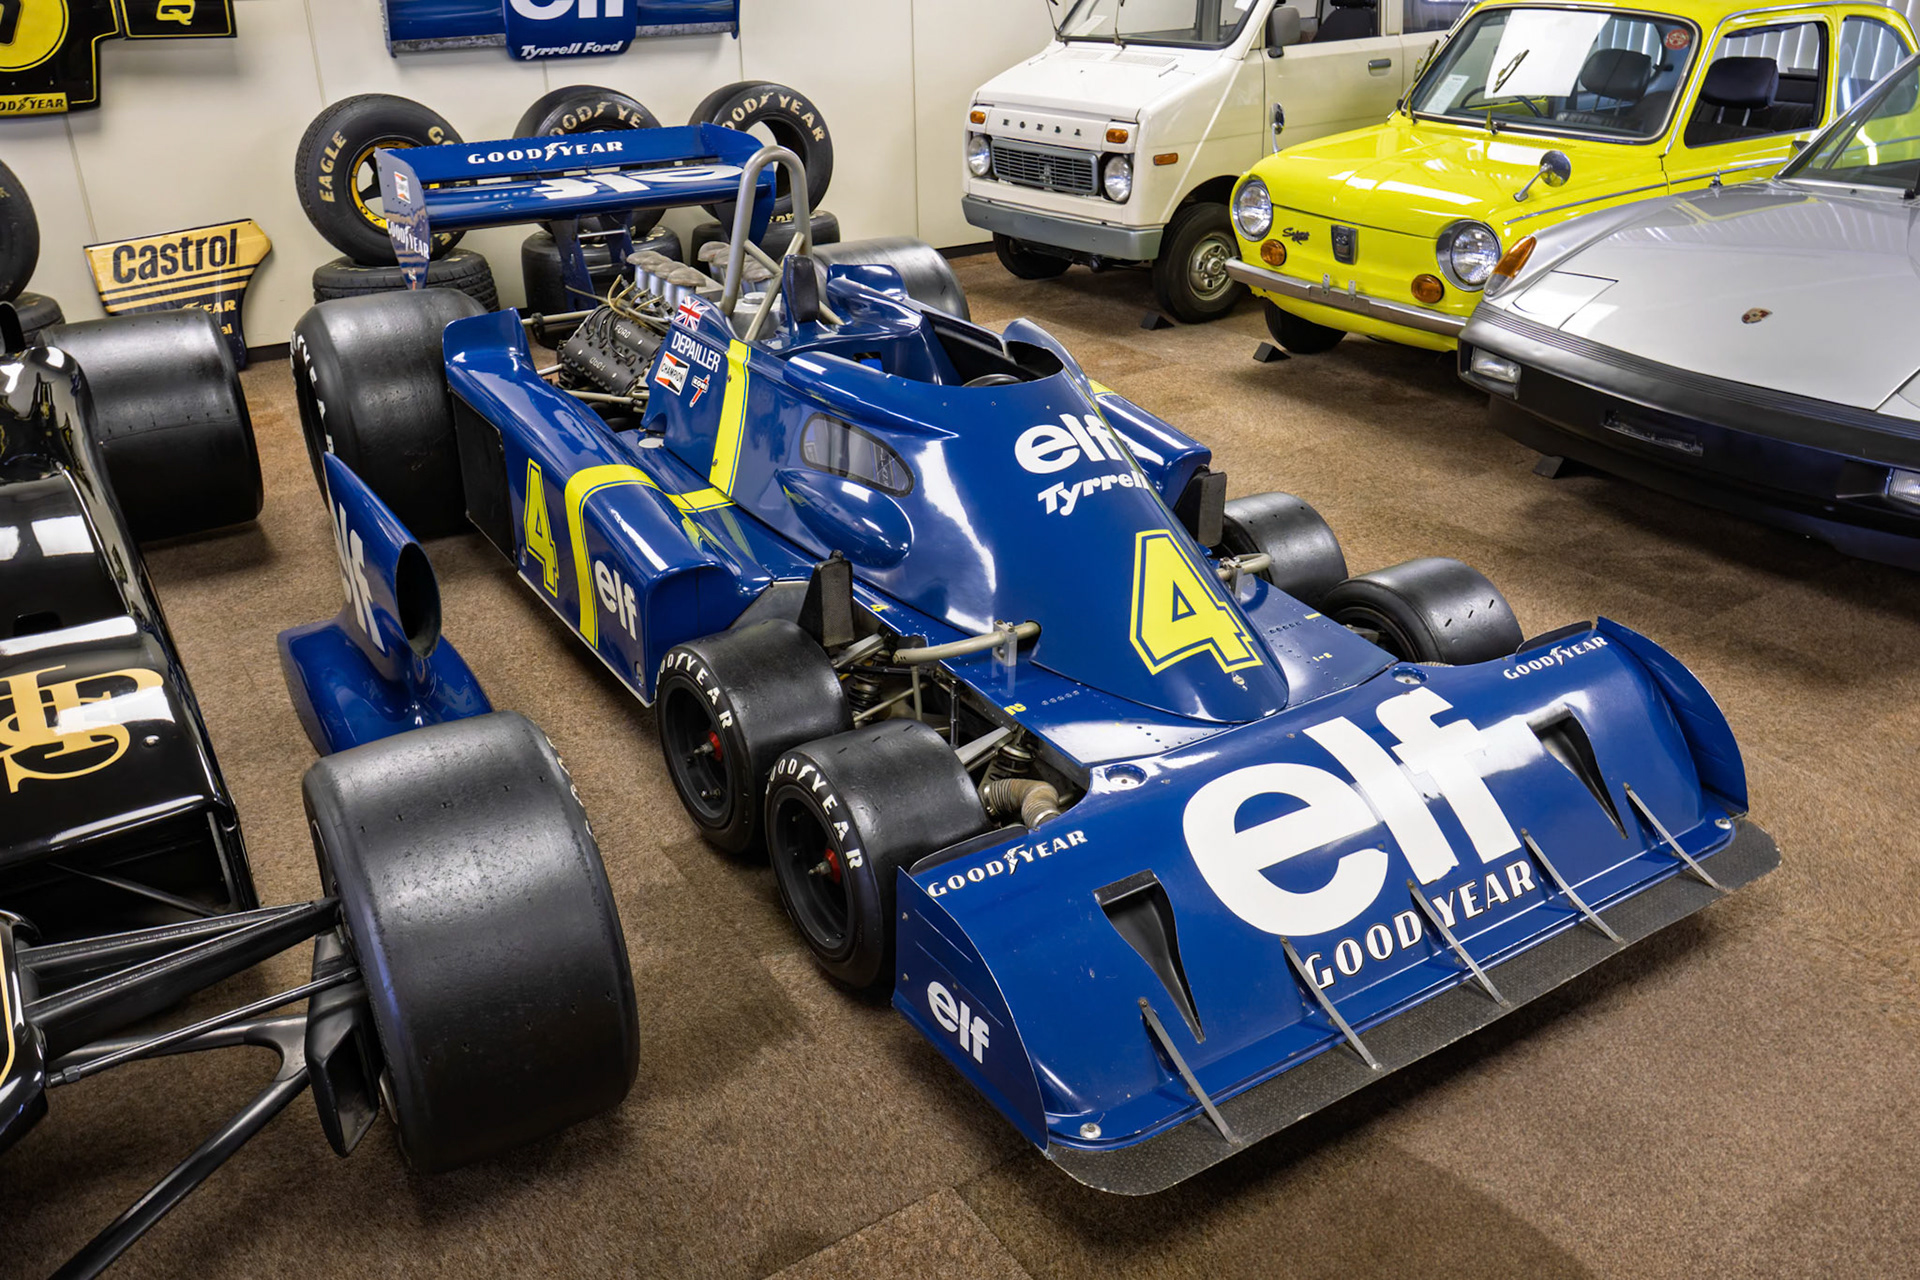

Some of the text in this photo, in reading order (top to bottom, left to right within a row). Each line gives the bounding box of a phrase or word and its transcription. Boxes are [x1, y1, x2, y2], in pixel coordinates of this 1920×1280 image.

[521, 40, 624, 60] Tyrrell Ford
[318, 130, 347, 203] EAGLE
[467, 141, 624, 162] GOODYEAR
[111, 228, 238, 285] Castrol
[660, 362, 685, 384] CHAMPION
[670, 331, 722, 374] DEPAILLER
[1015, 413, 1123, 474] elf
[523, 457, 560, 599] 4
[595, 559, 637, 641] elf
[1130, 529, 1264, 676] 4
[1503, 635, 1608, 680] GOODYEAR
[1183, 686, 1523, 937] elf
[927, 830, 1088, 898] GOODYEAR
[926, 980, 990, 1064] elf
